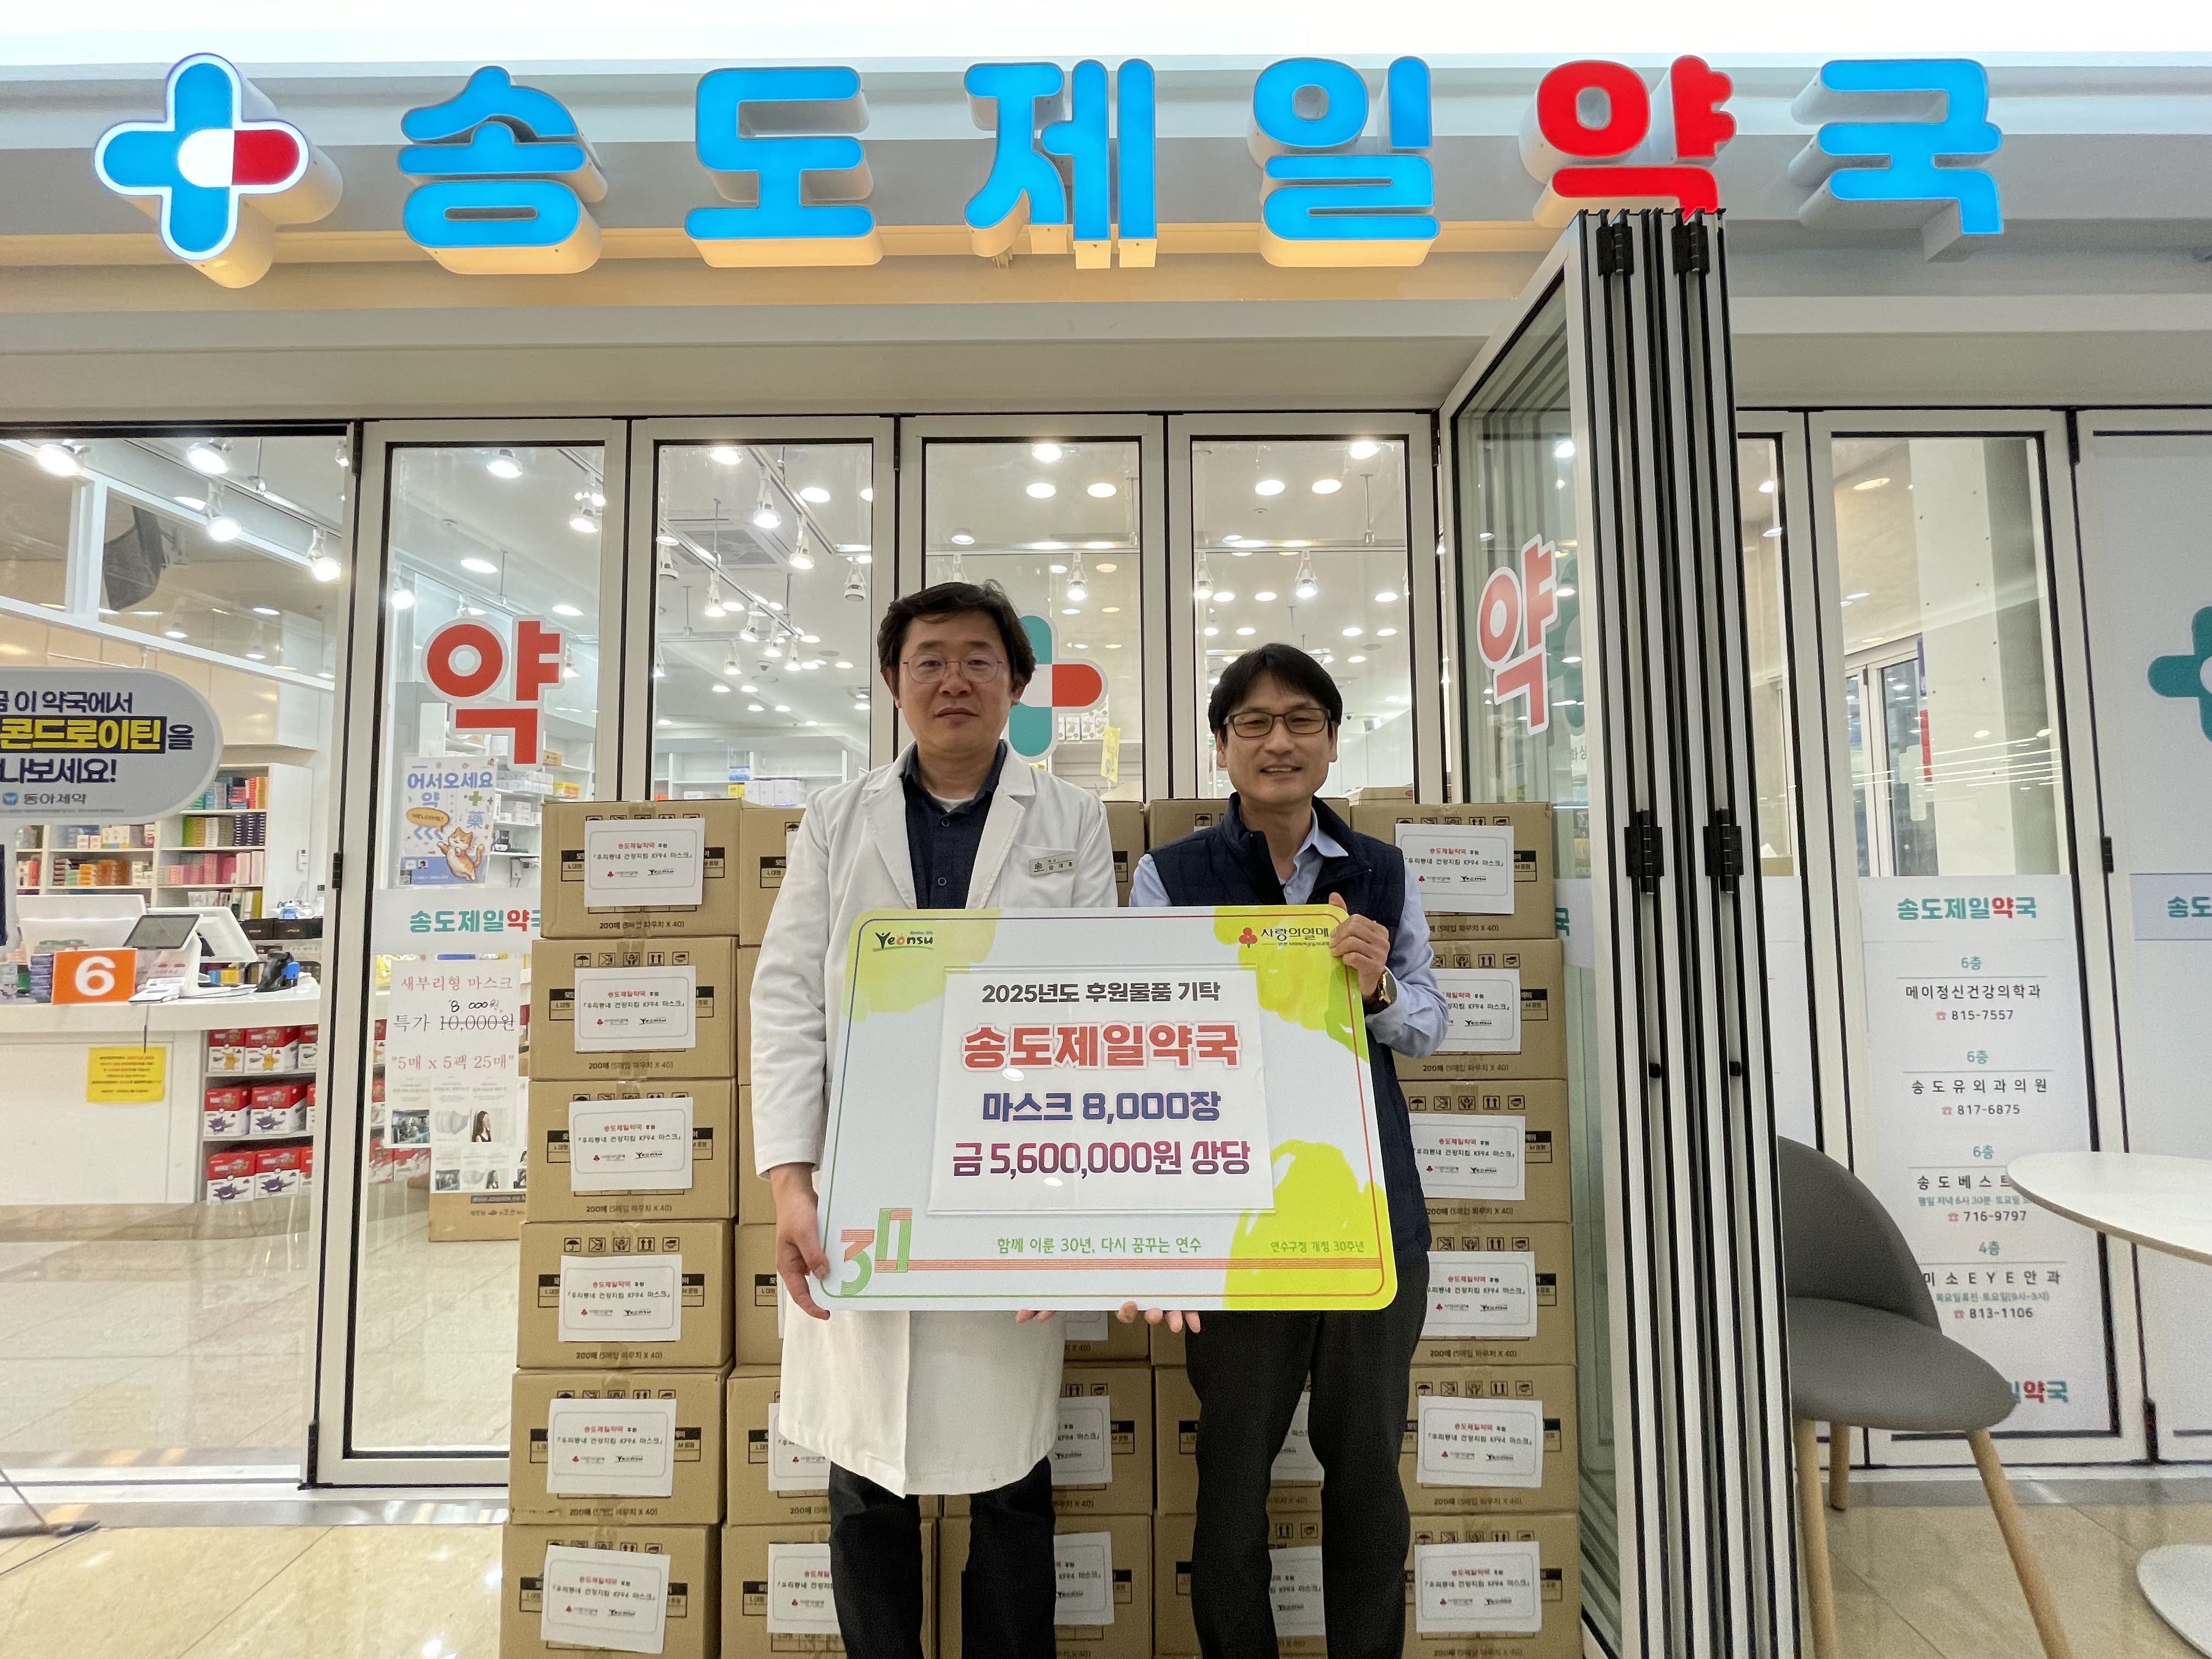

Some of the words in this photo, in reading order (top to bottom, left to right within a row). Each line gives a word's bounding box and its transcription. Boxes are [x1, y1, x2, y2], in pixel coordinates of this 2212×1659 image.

[398, 55, 2004, 247] 송도제일약국
[1480, 543, 1554, 727] 약
[427, 620, 560, 764] 약
[15, 690, 37, 713] 이
[42, 690, 133, 714] 약국에서
[407, 772, 493, 789] 어서오세요
[24, 793, 86, 805] 동아제약
[1897, 896, 2037, 921] 송도제일약국
[875, 932, 933, 949] Yeonsu
[1261, 927, 1329, 941] 사랑의열매
[1961, 956, 1982, 970] 6층
[75, 956, 115, 996] 6
[400, 975, 460, 991] 새부리형
[468, 975, 513, 991] 마스크
[982, 983, 1080, 1003] 2025년도
[1085, 982, 1171, 1003] 후원물품
[1178, 981, 1221, 1002] 기탁
[1905, 985, 2041, 1000] 메이정신건강의학과
[393, 1014, 430, 1032] 특가
[1951, 1010, 2014, 1020] 815-7557
[964, 1024, 1239, 1069] 송도제일약국
[443, 1054, 467, 1070] 5팩
[474, 1054, 514, 1070] 25매"
[1967, 1050, 1989, 1064] 6층
[1912, 1079, 2047, 1095] 송도유외과의원
[982, 1092, 1074, 1122] 마스크
[1082, 1091, 1221, 1124] 8,000장
[1957, 1104, 2021, 1115] 817-6875
[953, 1143, 983, 1176] 금
[990, 1141, 1182, 1180] 5,600,000원
[1190, 1141, 1251, 1175] 상당
[1973, 1146, 1995, 1160] 6층
[1963, 1211, 2027, 1222] 716-9797
[997, 1237, 1024, 1254] 함께
[1030, 1237, 1055, 1254] 이룬
[1061, 1237, 1095, 1254] 30년,
[1101, 1237, 1126, 1253] 다시
[1132, 1237, 1170, 1254] 꿈꾸는
[1176, 1237, 1202, 1254] 연수
[1271, 1241, 1307, 1253] 연수구청
[1333, 1241, 1364, 1253] 30주년
[1978, 1241, 2000, 1256] 4층
[1970, 1307, 2034, 1319] 813-1106
